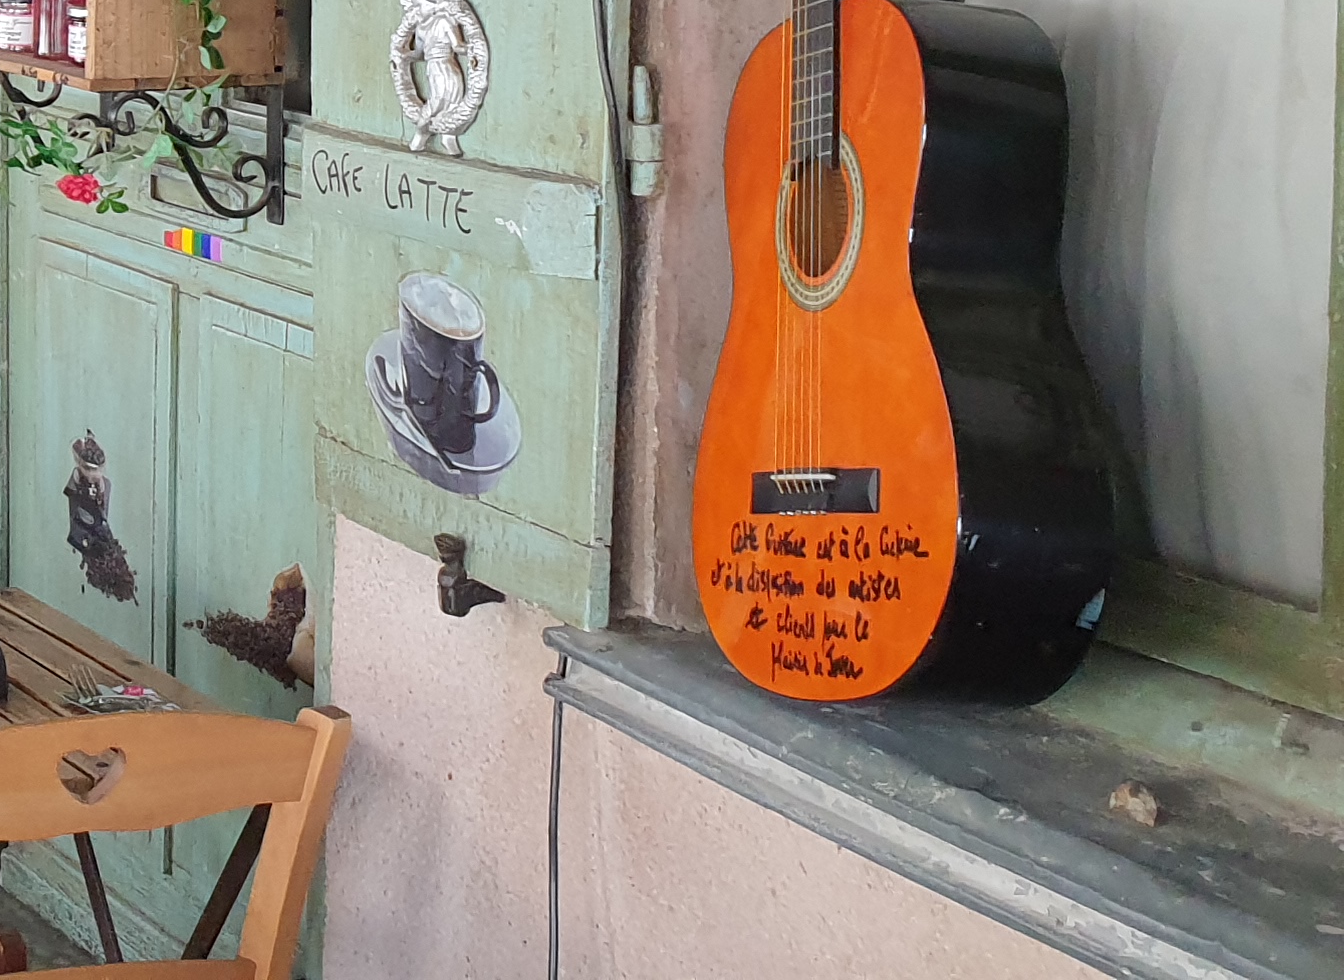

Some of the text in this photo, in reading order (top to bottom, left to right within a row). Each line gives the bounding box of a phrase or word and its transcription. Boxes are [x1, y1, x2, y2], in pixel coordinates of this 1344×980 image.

[312, 149, 474, 234] CAFE LATTE
[816, 530, 835, 561] est
[839, 525, 850, 559] à
[854, 525, 870, 562] la
[816, 569, 836, 600] des
[855, 611, 869, 642] le
